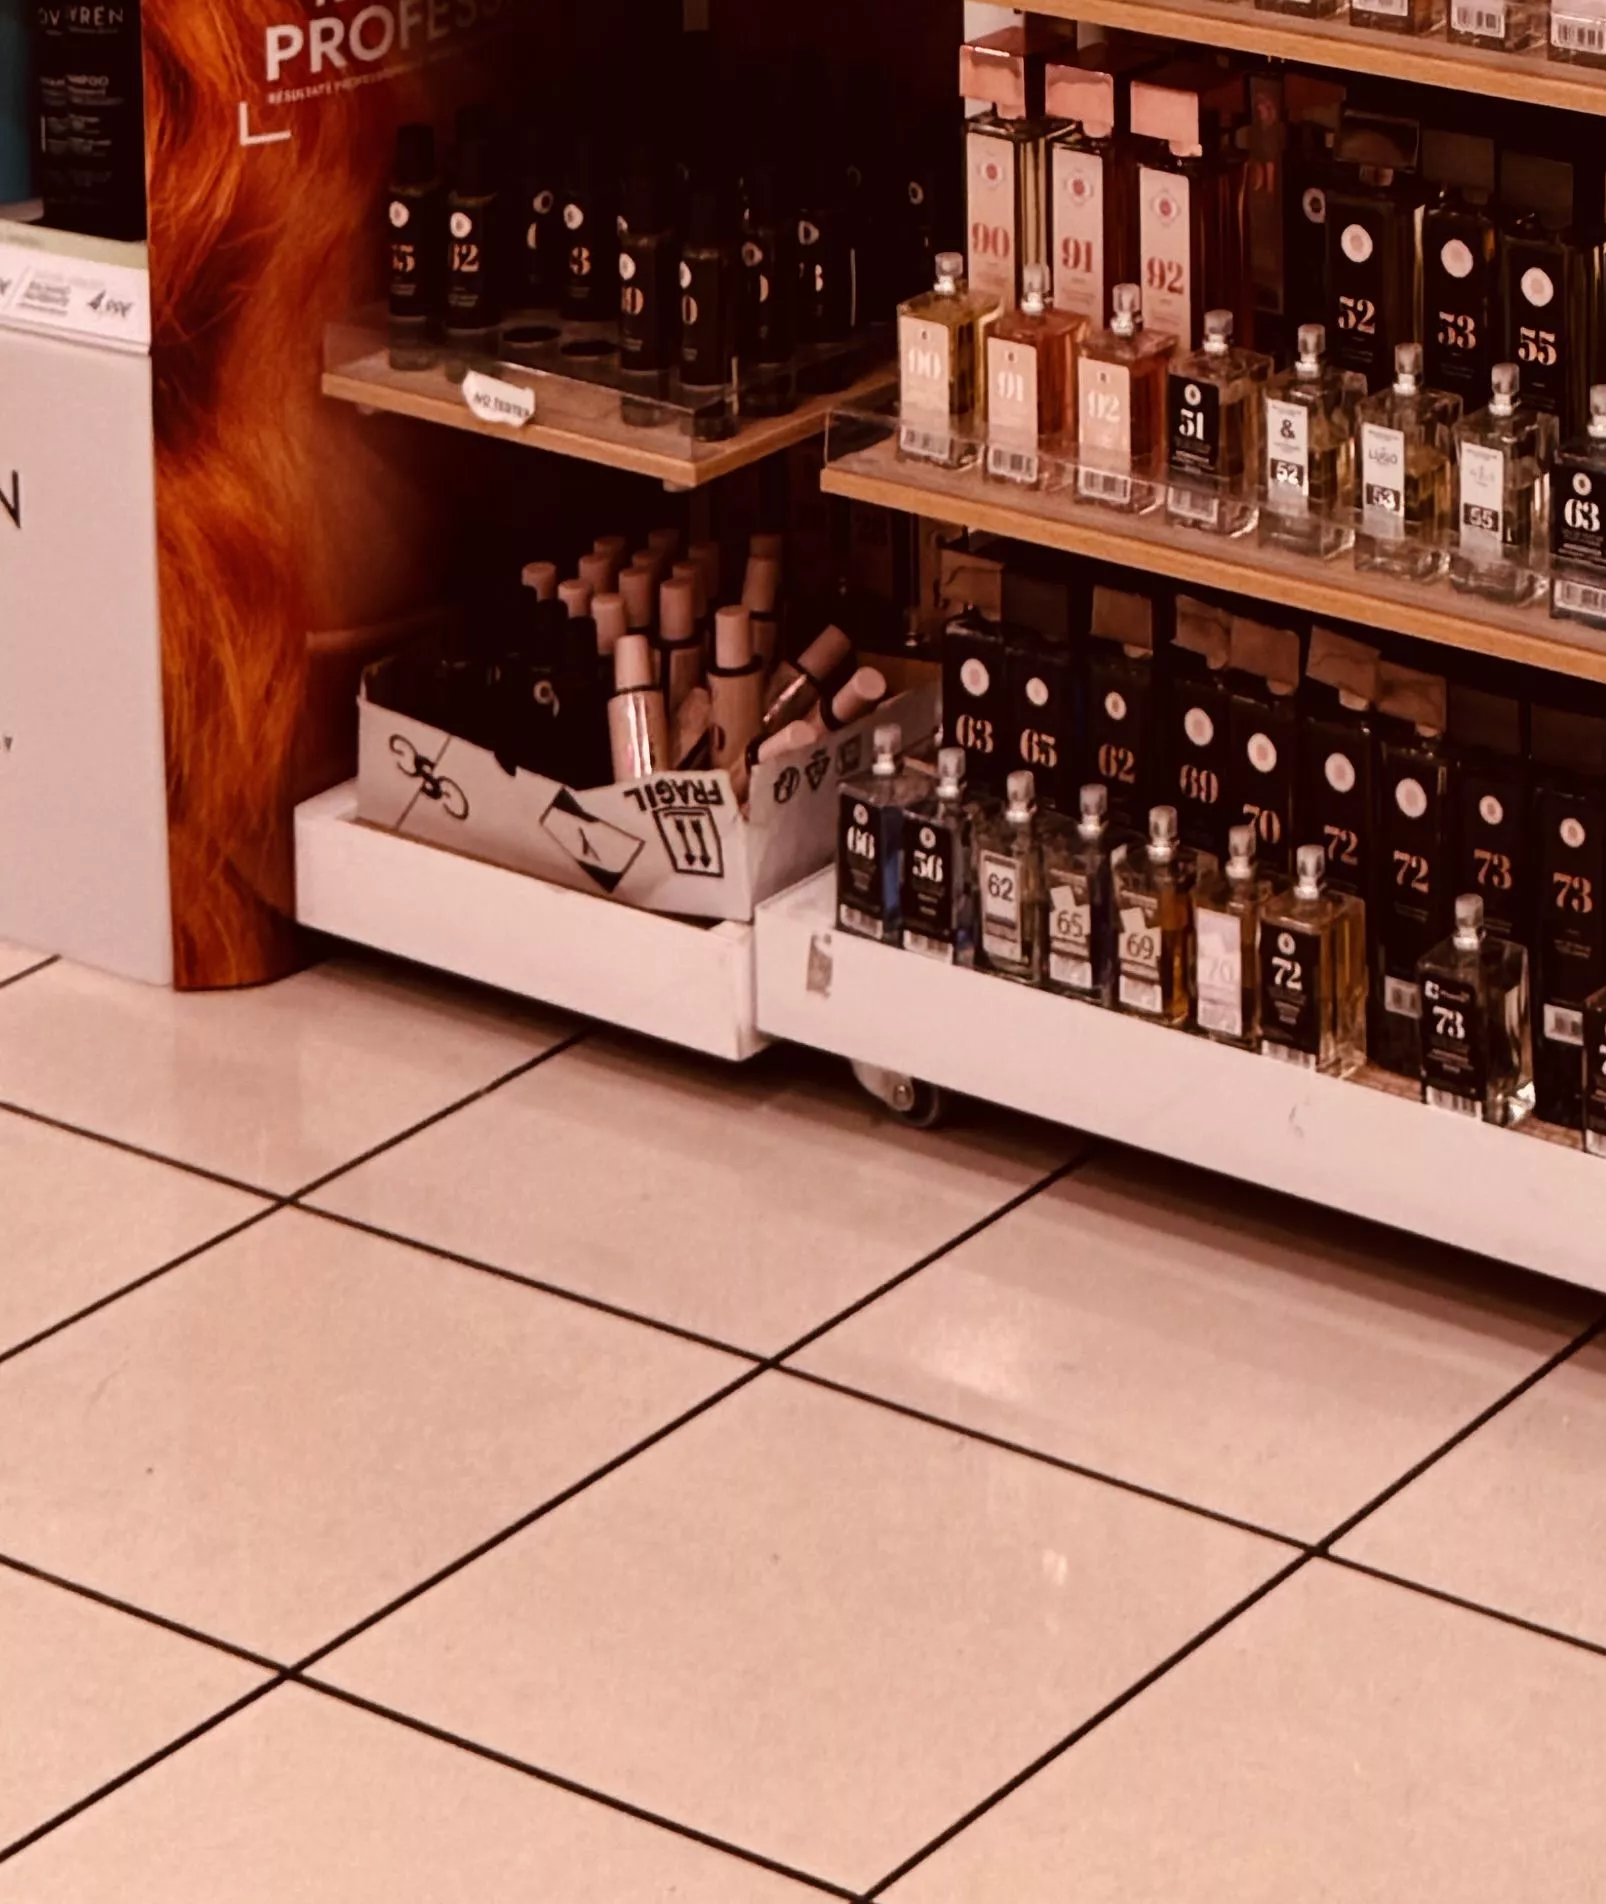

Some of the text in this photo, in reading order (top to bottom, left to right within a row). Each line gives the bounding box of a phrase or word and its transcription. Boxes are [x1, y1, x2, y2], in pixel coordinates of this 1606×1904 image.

[972, 222, 1011, 258] 90
[1146, 257, 1185, 294] 92
[1338, 297, 1376, 334] 52
[1518, 327, 1557, 366] 55
[1563, 499, 1600, 532] 63
[623, 779, 724, 812] FRAGIL
[1432, 1006, 1466, 1040] 73
